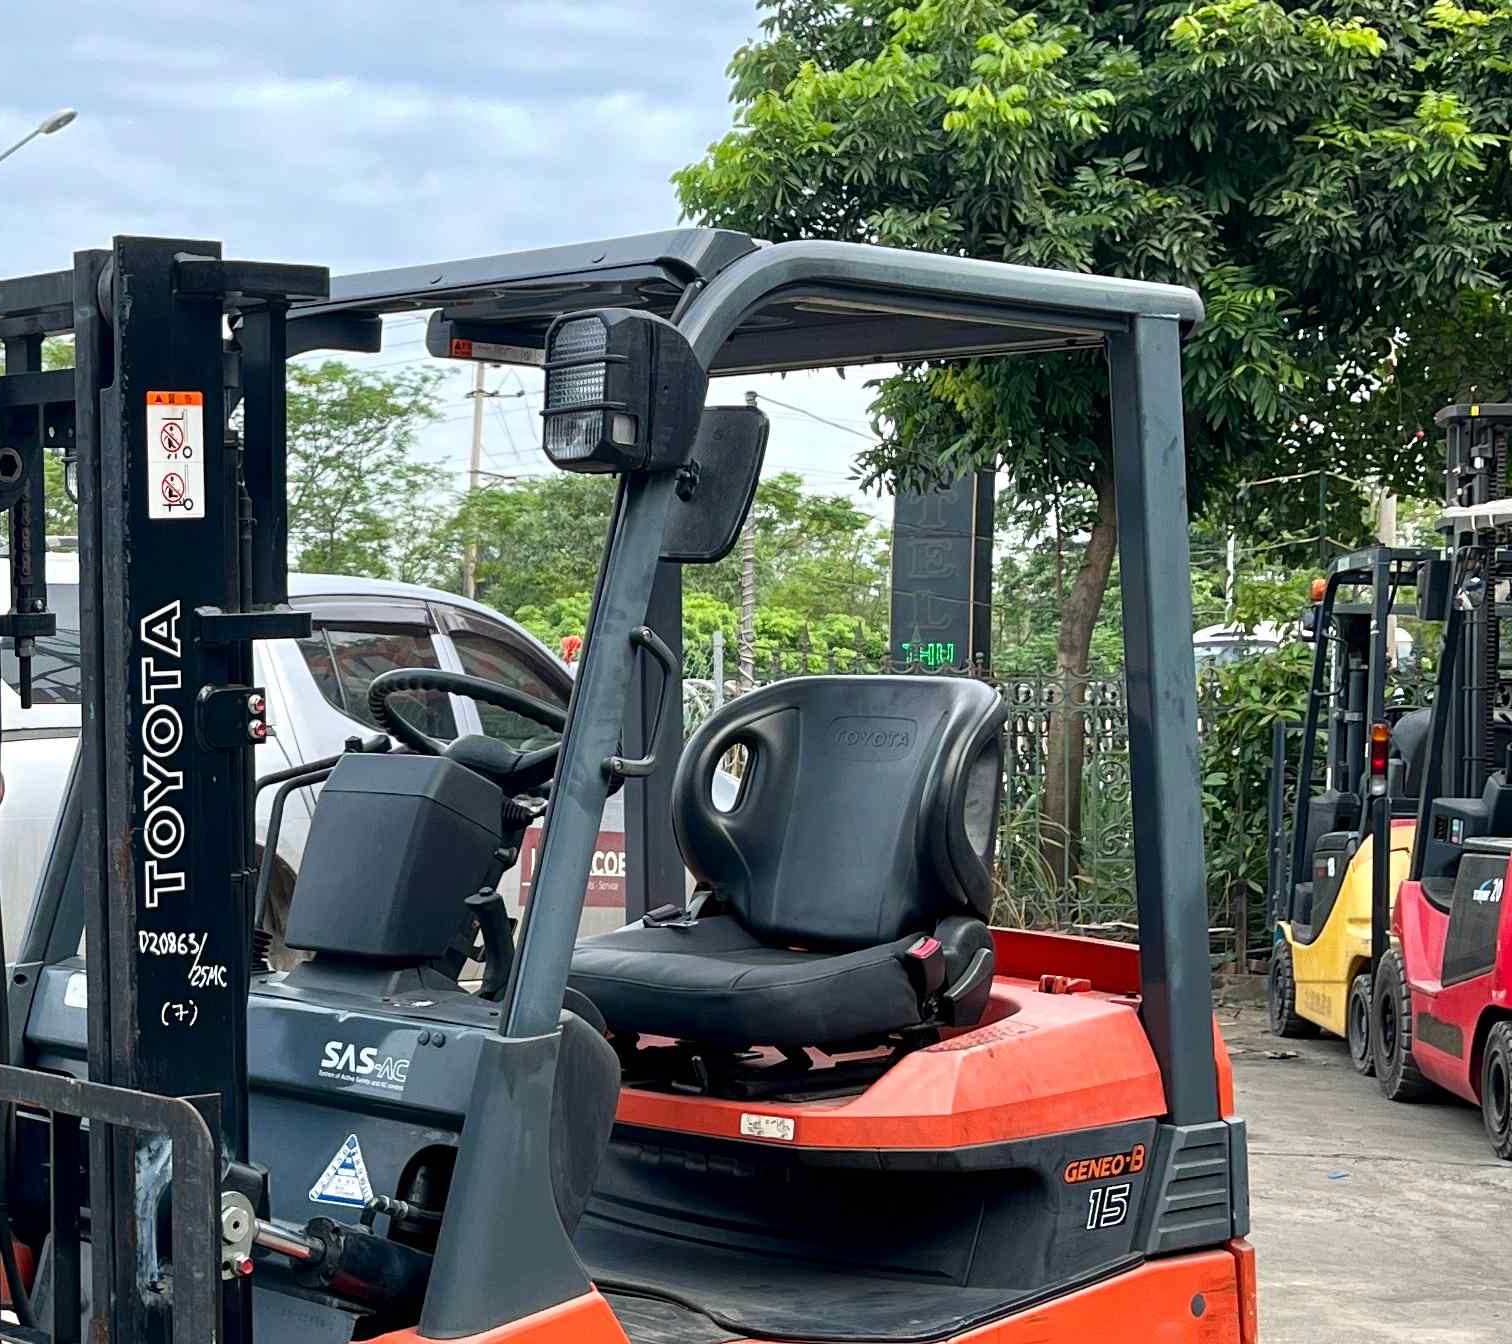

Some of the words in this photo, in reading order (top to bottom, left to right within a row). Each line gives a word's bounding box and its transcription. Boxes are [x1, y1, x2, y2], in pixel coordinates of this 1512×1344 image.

[141, 599, 185, 908] TOYOTA
[834, 729, 909, 747] TOYOTA
[1087, 1183, 1131, 1230] 15
